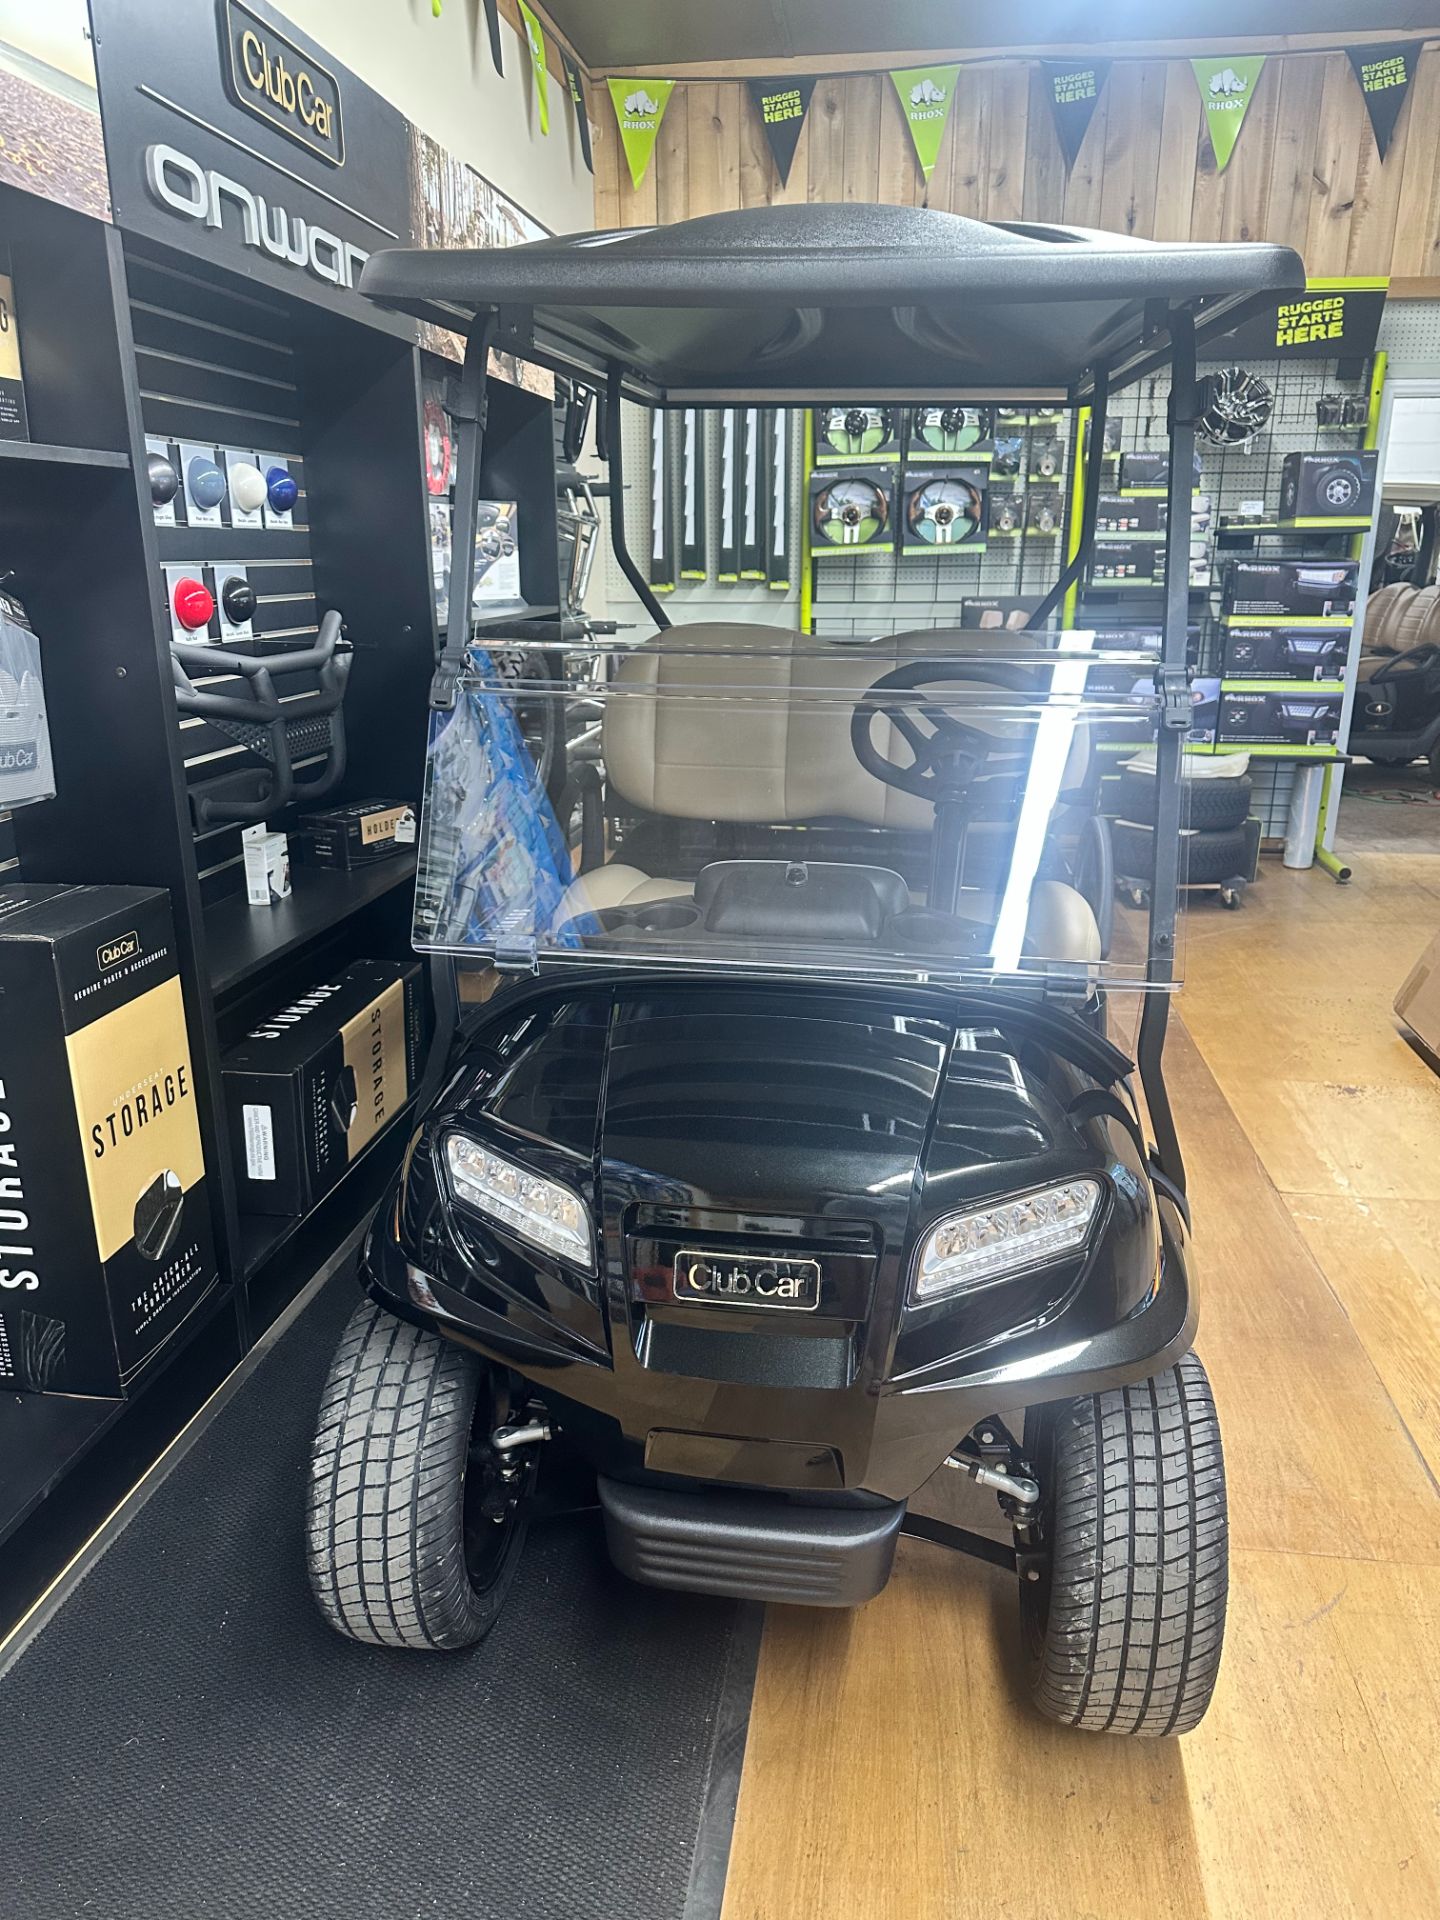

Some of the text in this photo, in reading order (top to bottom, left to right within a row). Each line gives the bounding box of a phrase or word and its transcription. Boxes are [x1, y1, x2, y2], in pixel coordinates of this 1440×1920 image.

[1361, 56, 1404, 73] RUGGED
[1363, 65, 1406, 80] STARTS
[242, 30, 333, 139] Club Car
[1054, 71, 1095, 86] RUGGED
[1055, 79, 1095, 93] STARTS
[1363, 73, 1408, 92] HERE
[761, 90, 801, 106] RUGGED
[1055, 86, 1096, 103] HERE
[763, 98, 801, 112] STARTS
[1208, 99, 1244, 110] RHOX
[764, 106, 803, 124] HERE
[910, 108, 944, 121] RHOX
[623, 120, 655, 130] RHOX
[145, 144, 371, 289] onwar
[1278, 297, 1345, 317] RUGGED
[1278, 311, 1343, 328] STARTS
[1276, 321, 1344, 347] HERE
[367, 817, 400, 836] HOLDE
[101, 940, 135, 964] Club Car
[371, 1008, 385, 1124] STORAGE
[112, 1067, 164, 1107] UNDERSEAT
[92, 1065, 189, 1158] STORAGE
[688, 1263, 806, 1298] Club Car
[131, 1291, 148, 1312] THE
